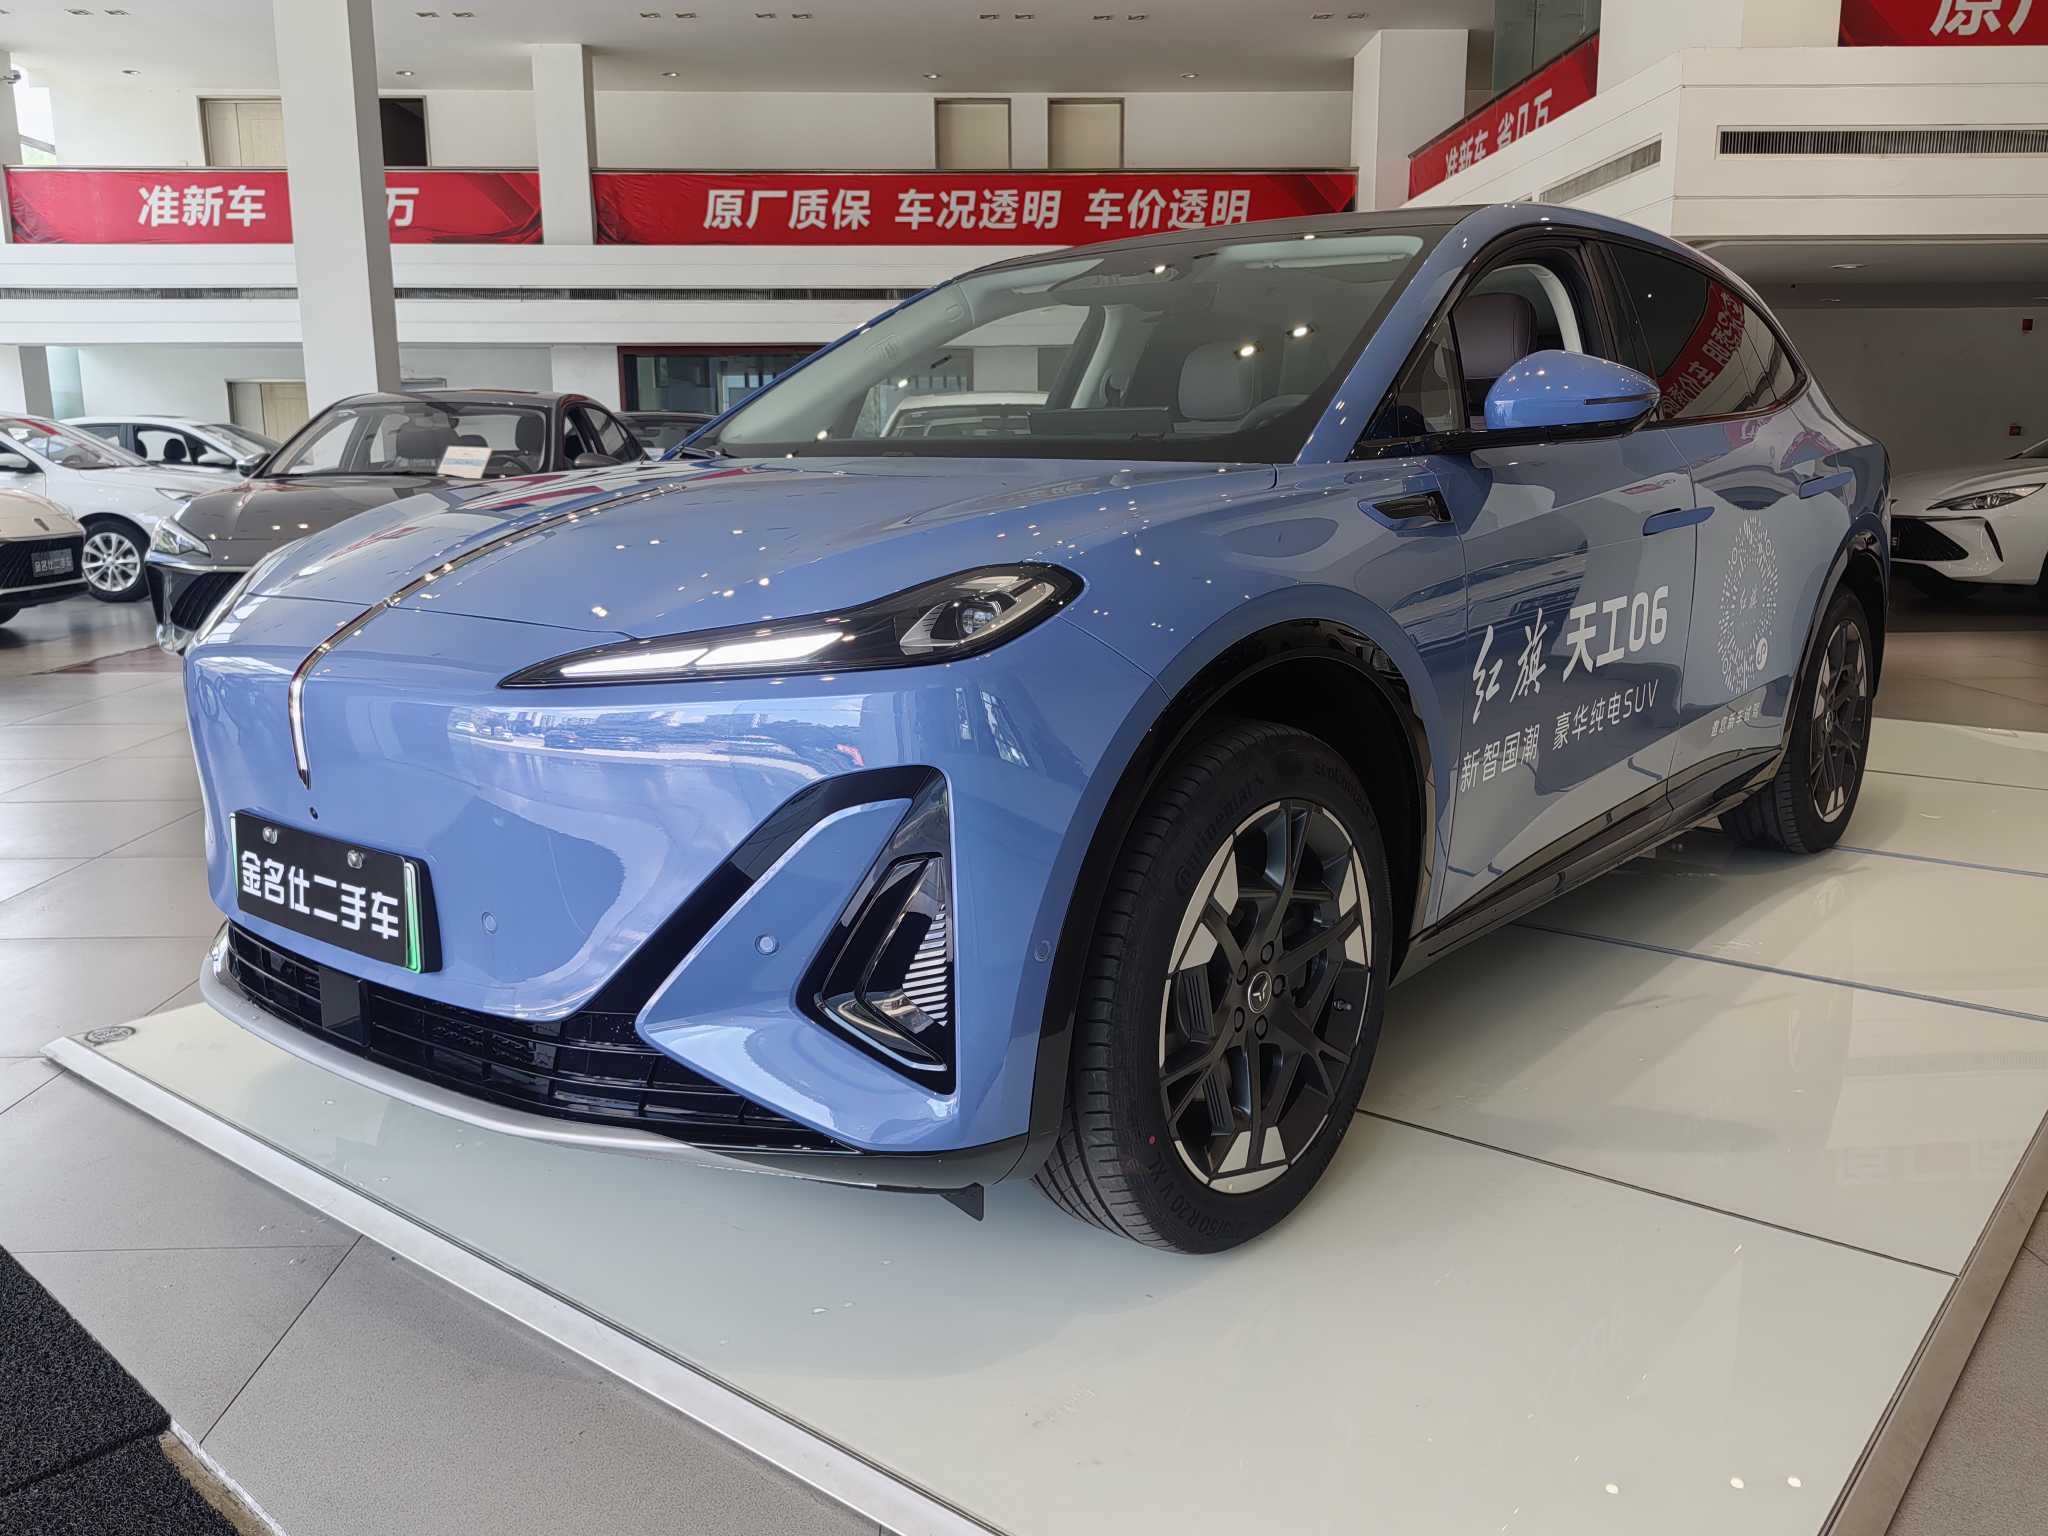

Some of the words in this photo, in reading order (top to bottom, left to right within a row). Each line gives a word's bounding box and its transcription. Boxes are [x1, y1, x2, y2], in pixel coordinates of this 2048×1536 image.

[138, 184, 266, 227] 准新车
[703, 188, 871, 230] 原厂质保
[895, 188, 1062, 230] 车况透明
[1084, 188, 1250, 229] 车价透明
[1472, 607, 1549, 724] 红旗
[1562, 584, 1669, 683] 天工06
[1460, 724, 1540, 793] 新智国潮
[1552, 679, 1659, 751] 豪华纯电SUV
[241, 850, 399, 940] 金名仕二手车
